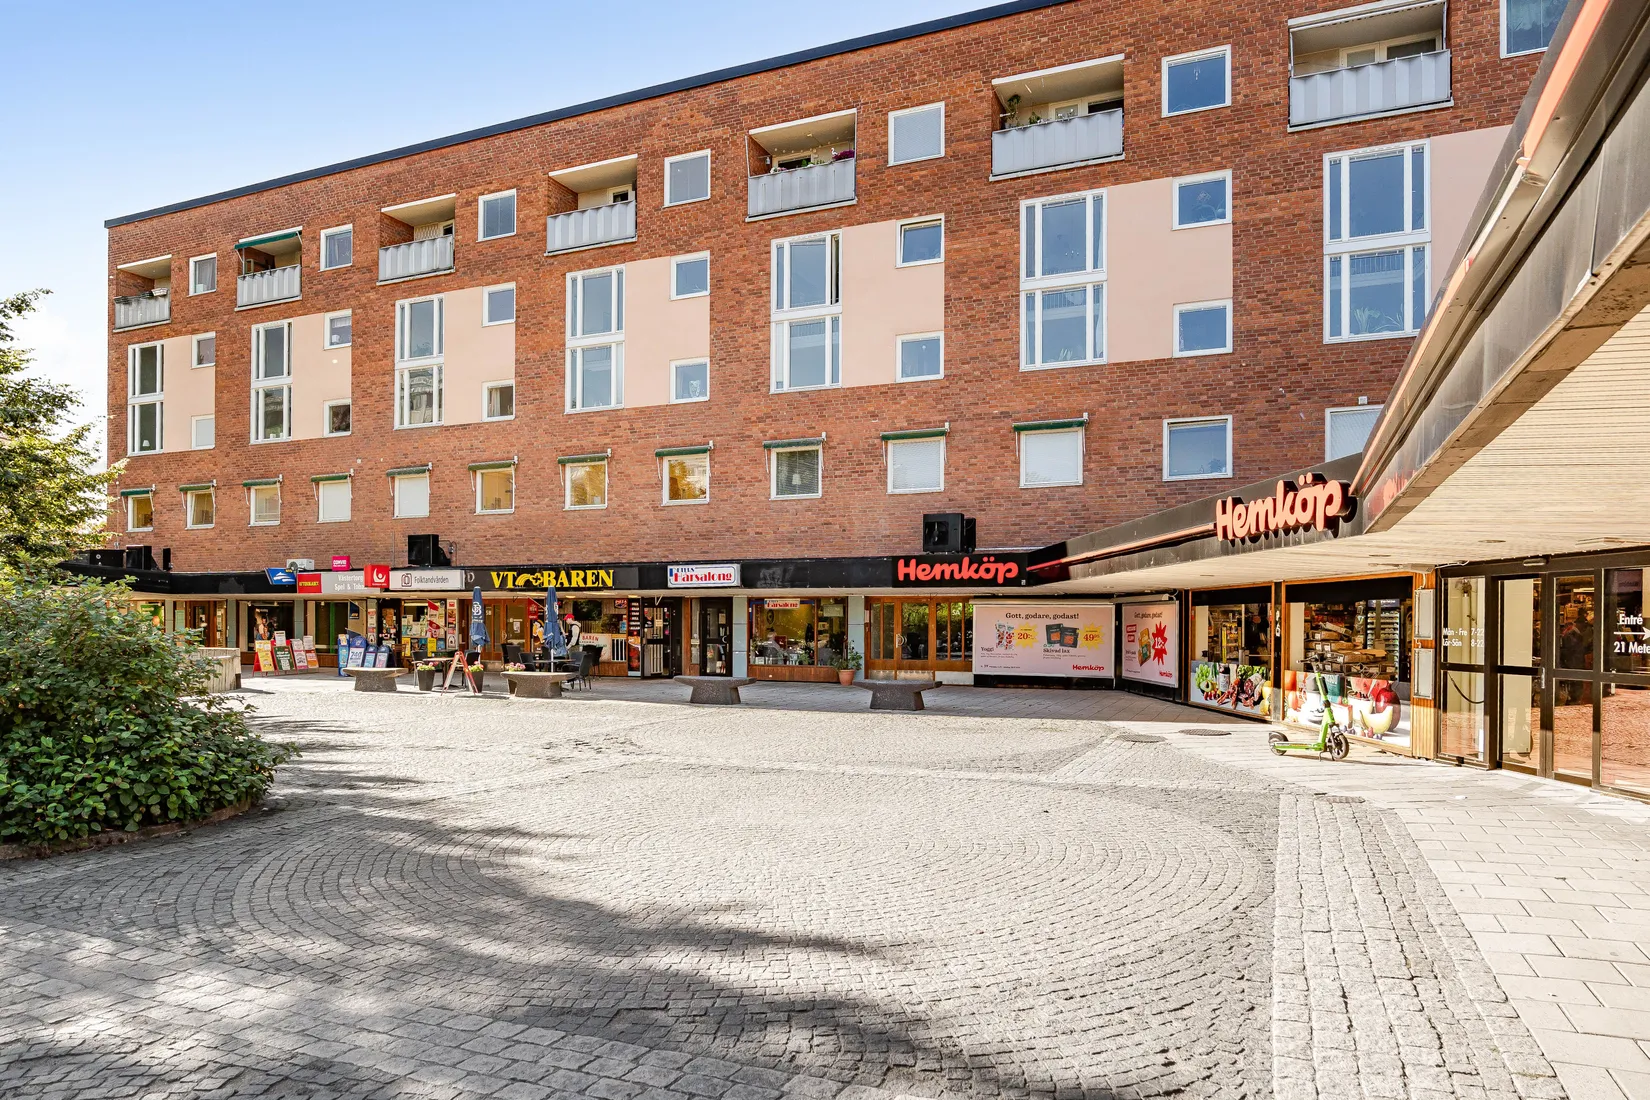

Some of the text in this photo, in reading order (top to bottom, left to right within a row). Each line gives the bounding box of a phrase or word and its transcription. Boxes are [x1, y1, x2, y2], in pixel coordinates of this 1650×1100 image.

[1216, 472, 1343, 542] Hemköp
[898, 556, 1018, 584] Hemköp
[414, 576, 449, 584] Folktandvården
[490, 569, 614, 589] VT BAREN
[1619, 613, 1643, 625] Entré
[1458, 628, 1467, 636] Fre
[1471, 628, 1485, 636] 7-22
[1471, 638, 1485, 647] 8-22
[1613, 641, 1626, 653] 21
[1072, 664, 1105, 672] Hemköp
